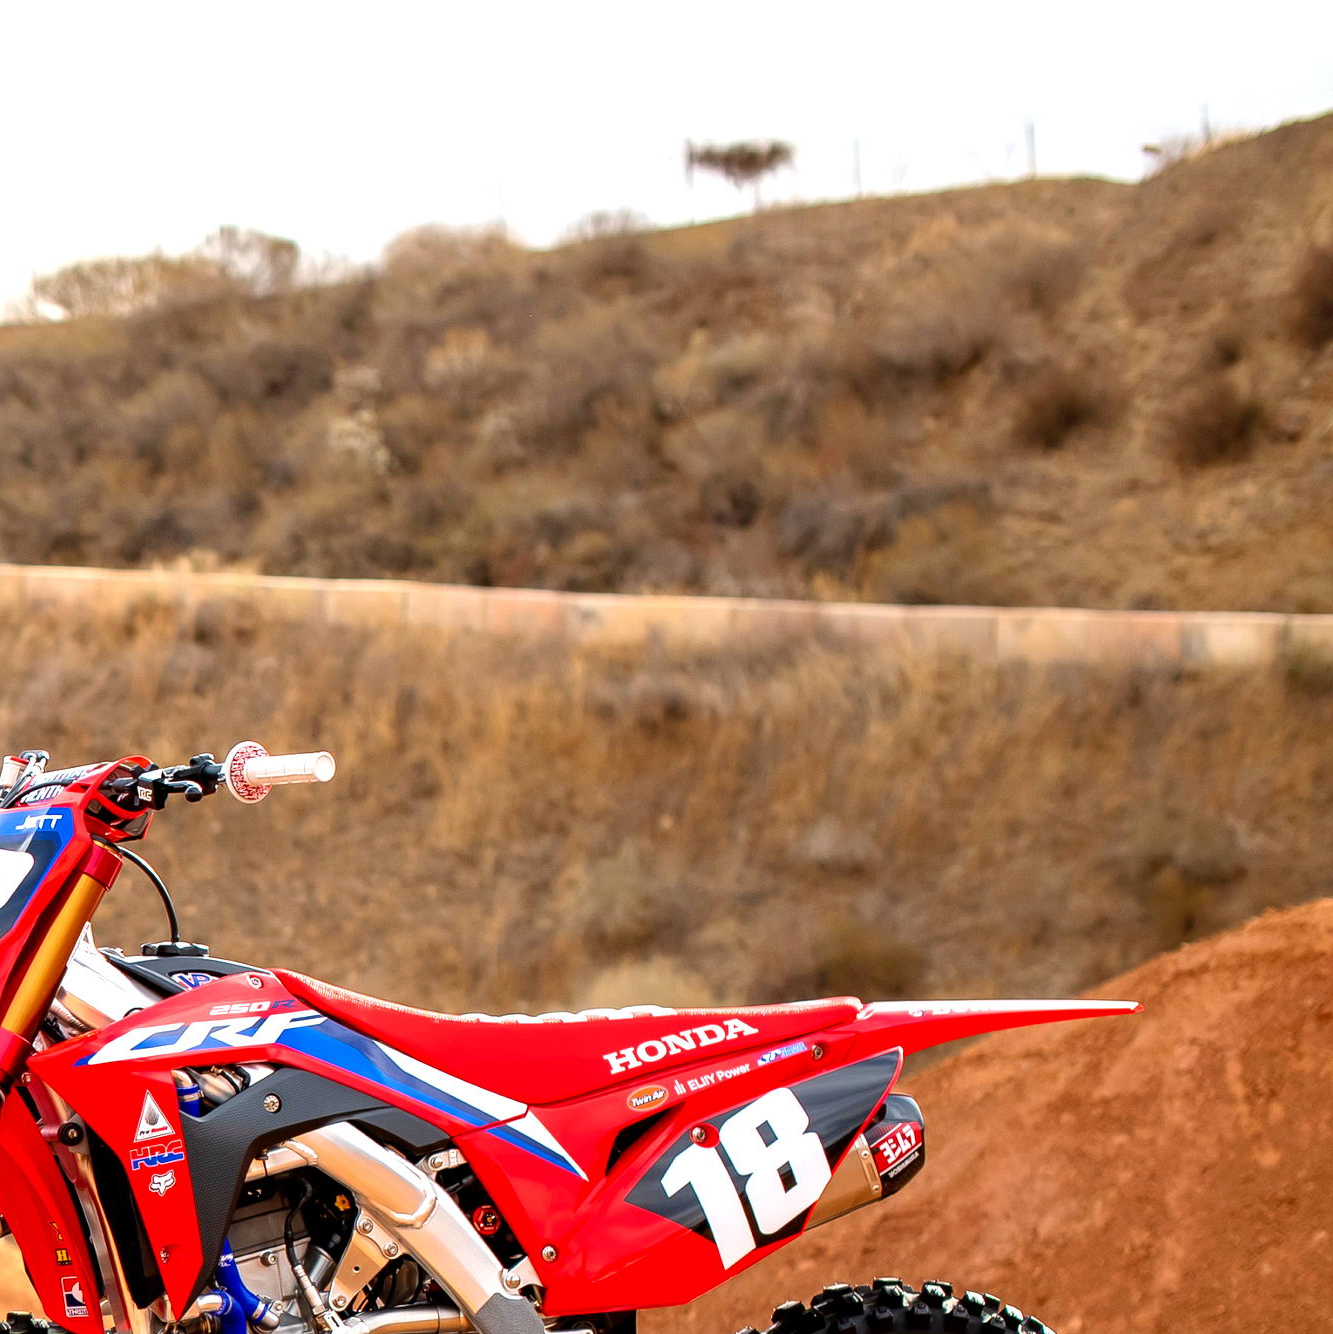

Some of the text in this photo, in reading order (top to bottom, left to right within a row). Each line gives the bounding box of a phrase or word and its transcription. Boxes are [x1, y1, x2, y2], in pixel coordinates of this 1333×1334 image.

[15, 814, 63, 830] JETT
[209, 999, 297, 1016] 250R
[87, 1009, 329, 1066] CRF
[602, 1018, 759, 1075] HONDA
[716, 1063, 751, 1082] Power
[631, 1089, 666, 1108] Twin Air
[129, 1139, 184, 1171] HRC
[660, 1086, 833, 1270] 18
